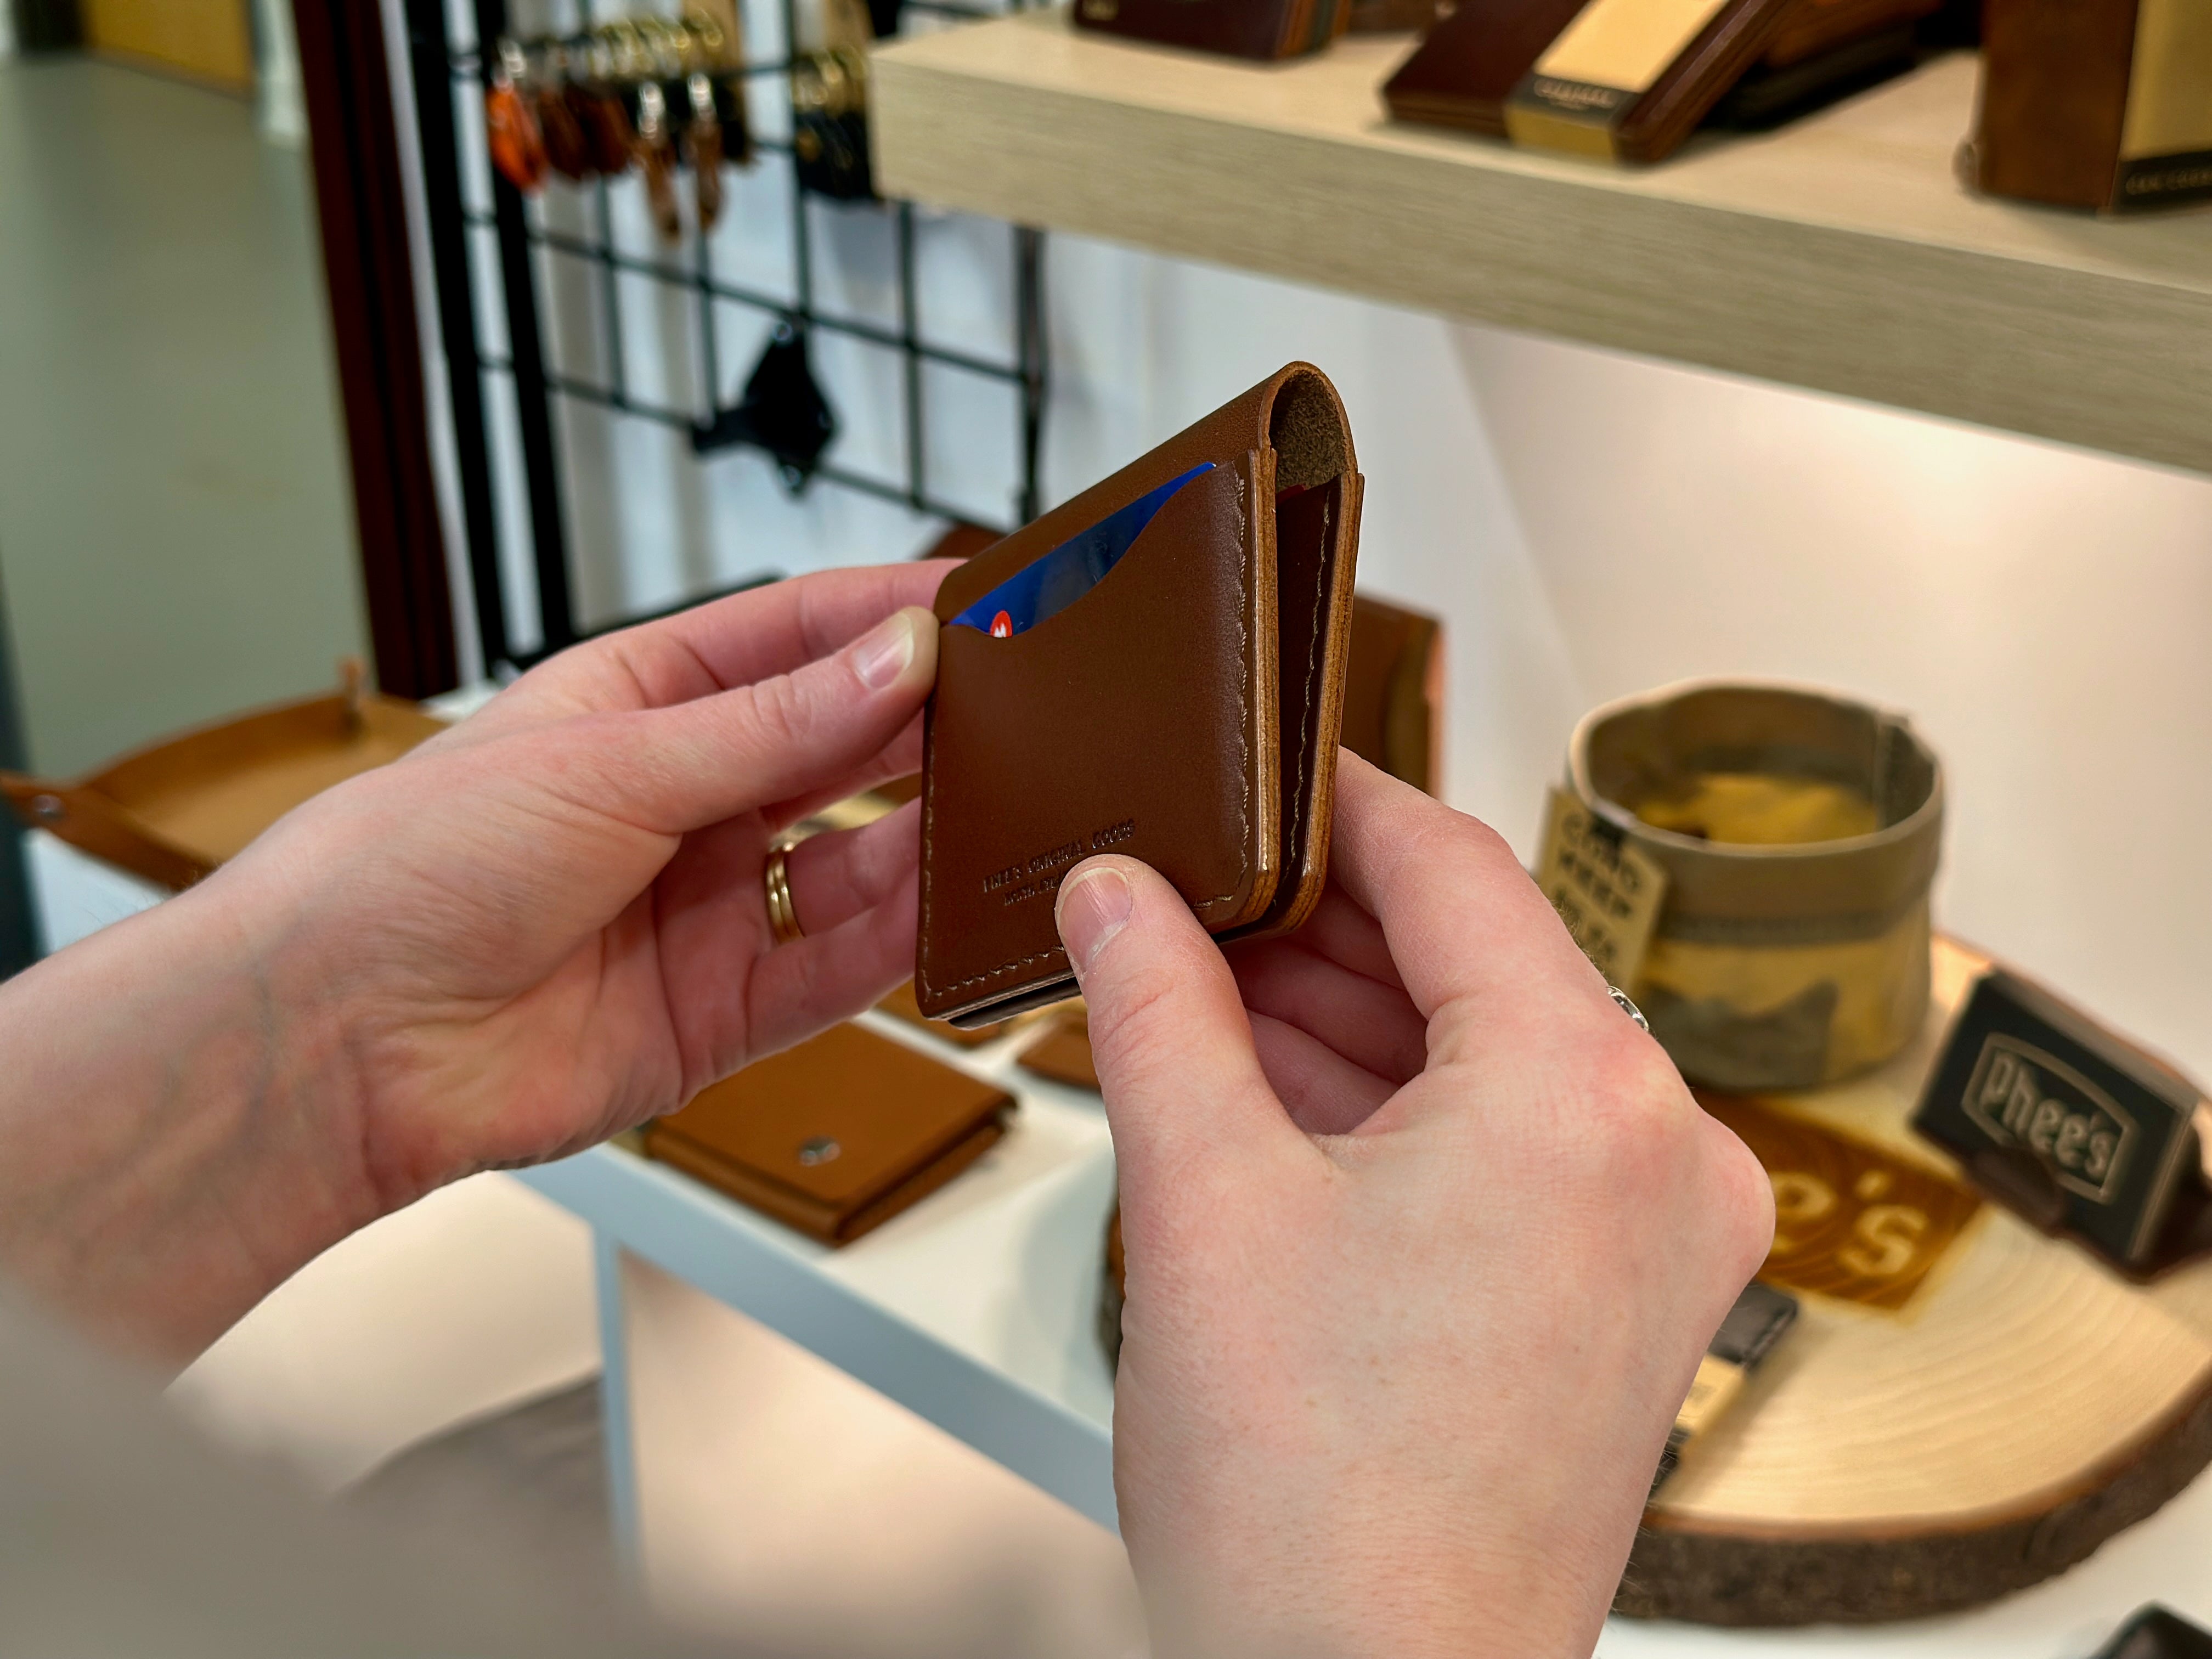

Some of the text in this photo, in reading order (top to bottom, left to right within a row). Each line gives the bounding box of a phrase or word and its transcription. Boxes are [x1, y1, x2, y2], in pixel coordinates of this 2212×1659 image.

[1092, 818, 1135, 849] GOODS
[1976, 1051, 2121, 1180] Phee's
[1771, 1170, 1929, 1276] e's
